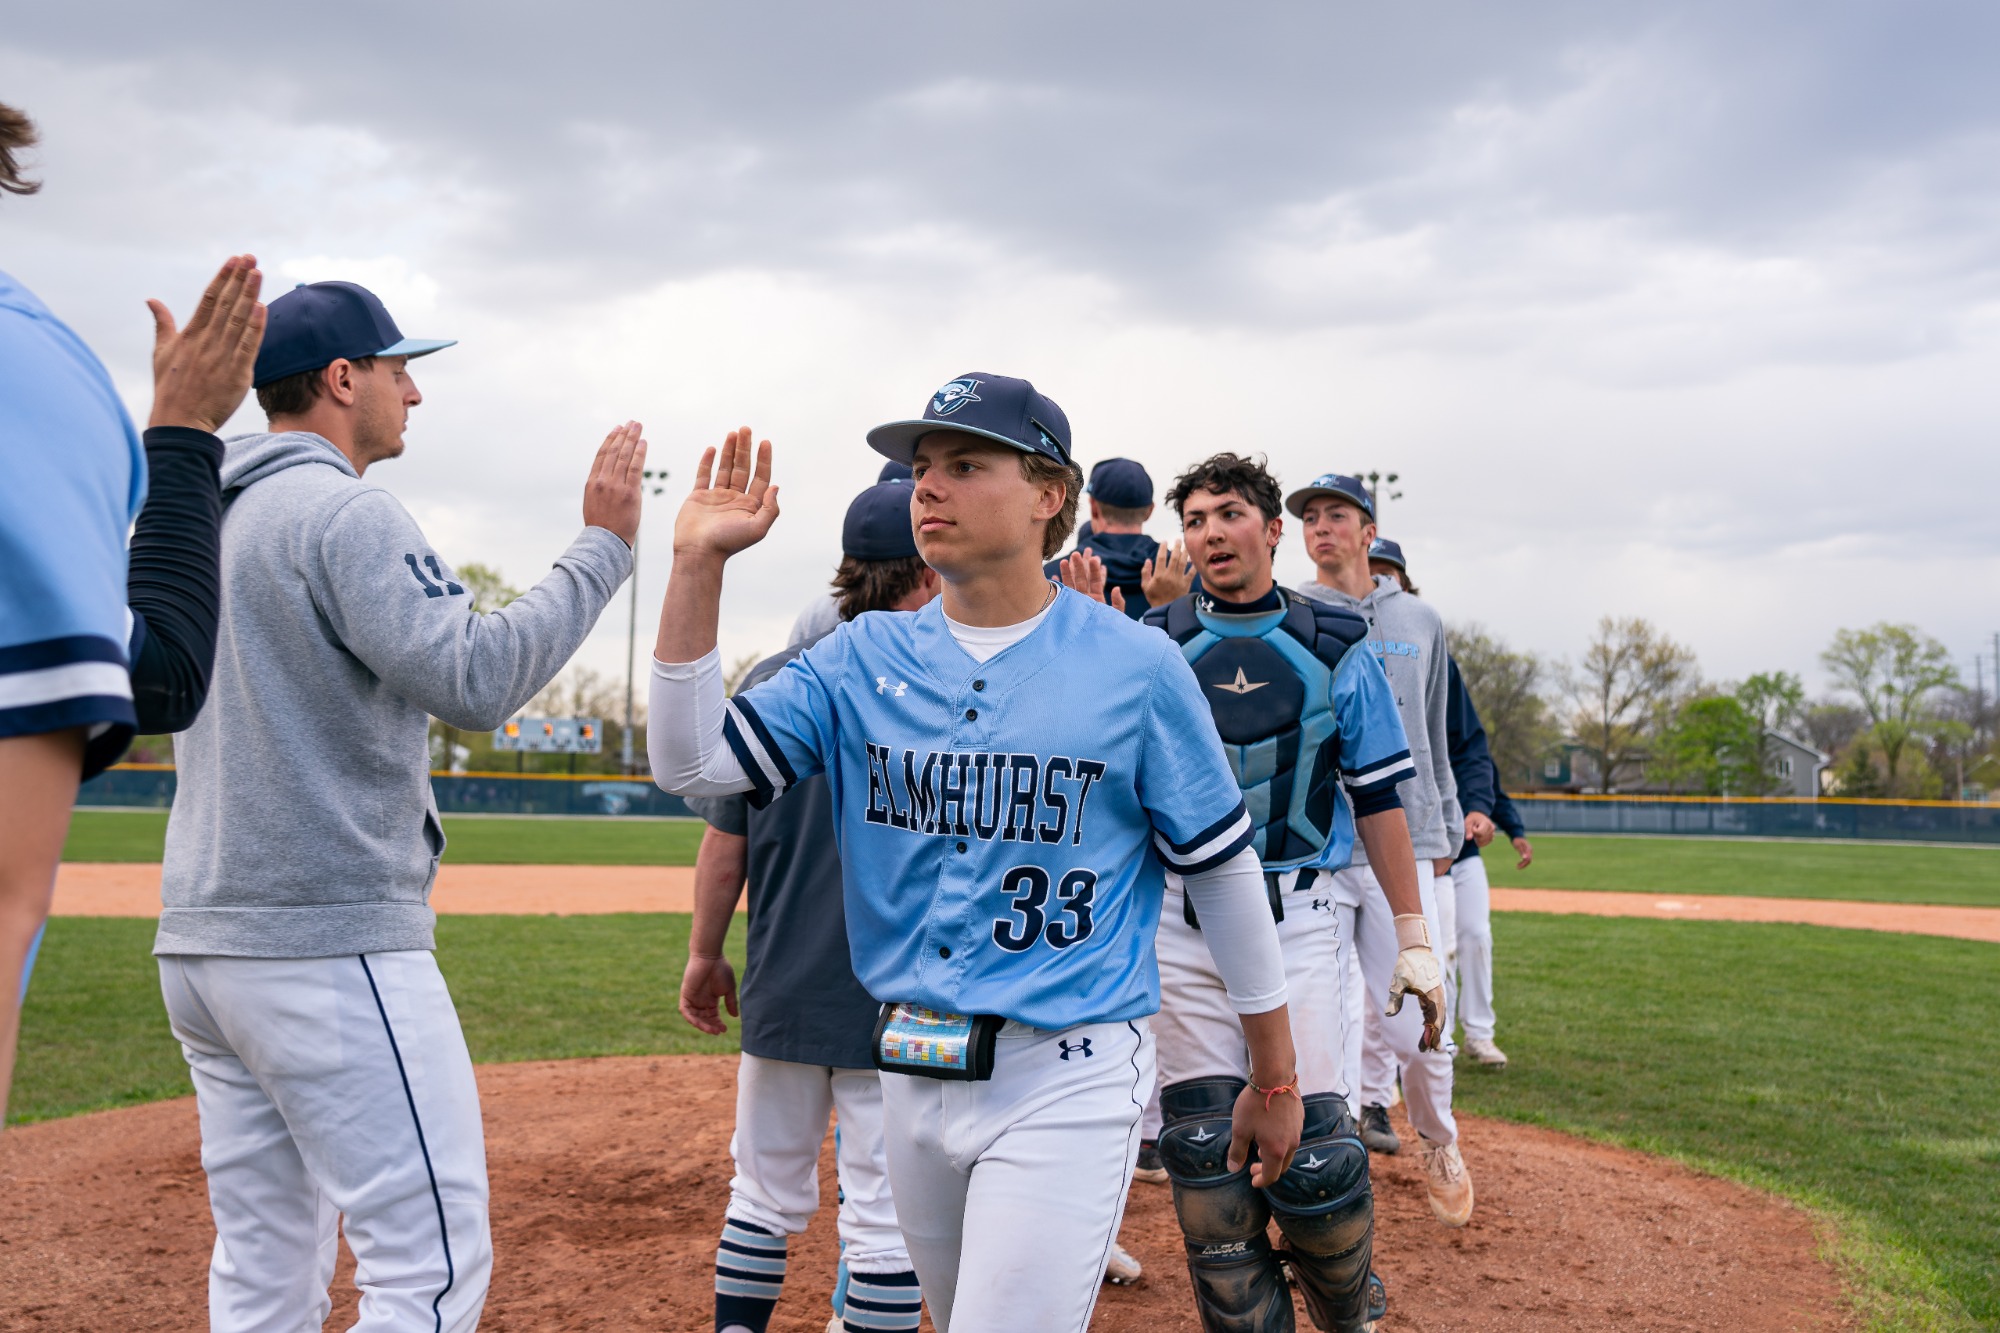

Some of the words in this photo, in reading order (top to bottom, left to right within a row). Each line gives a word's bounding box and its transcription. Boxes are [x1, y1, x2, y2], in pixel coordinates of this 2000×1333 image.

[404, 553, 464, 598] 11
[1368, 640, 1420, 660] URST
[865, 739, 1107, 847] ELMHURST
[992, 864, 1099, 953] 33
